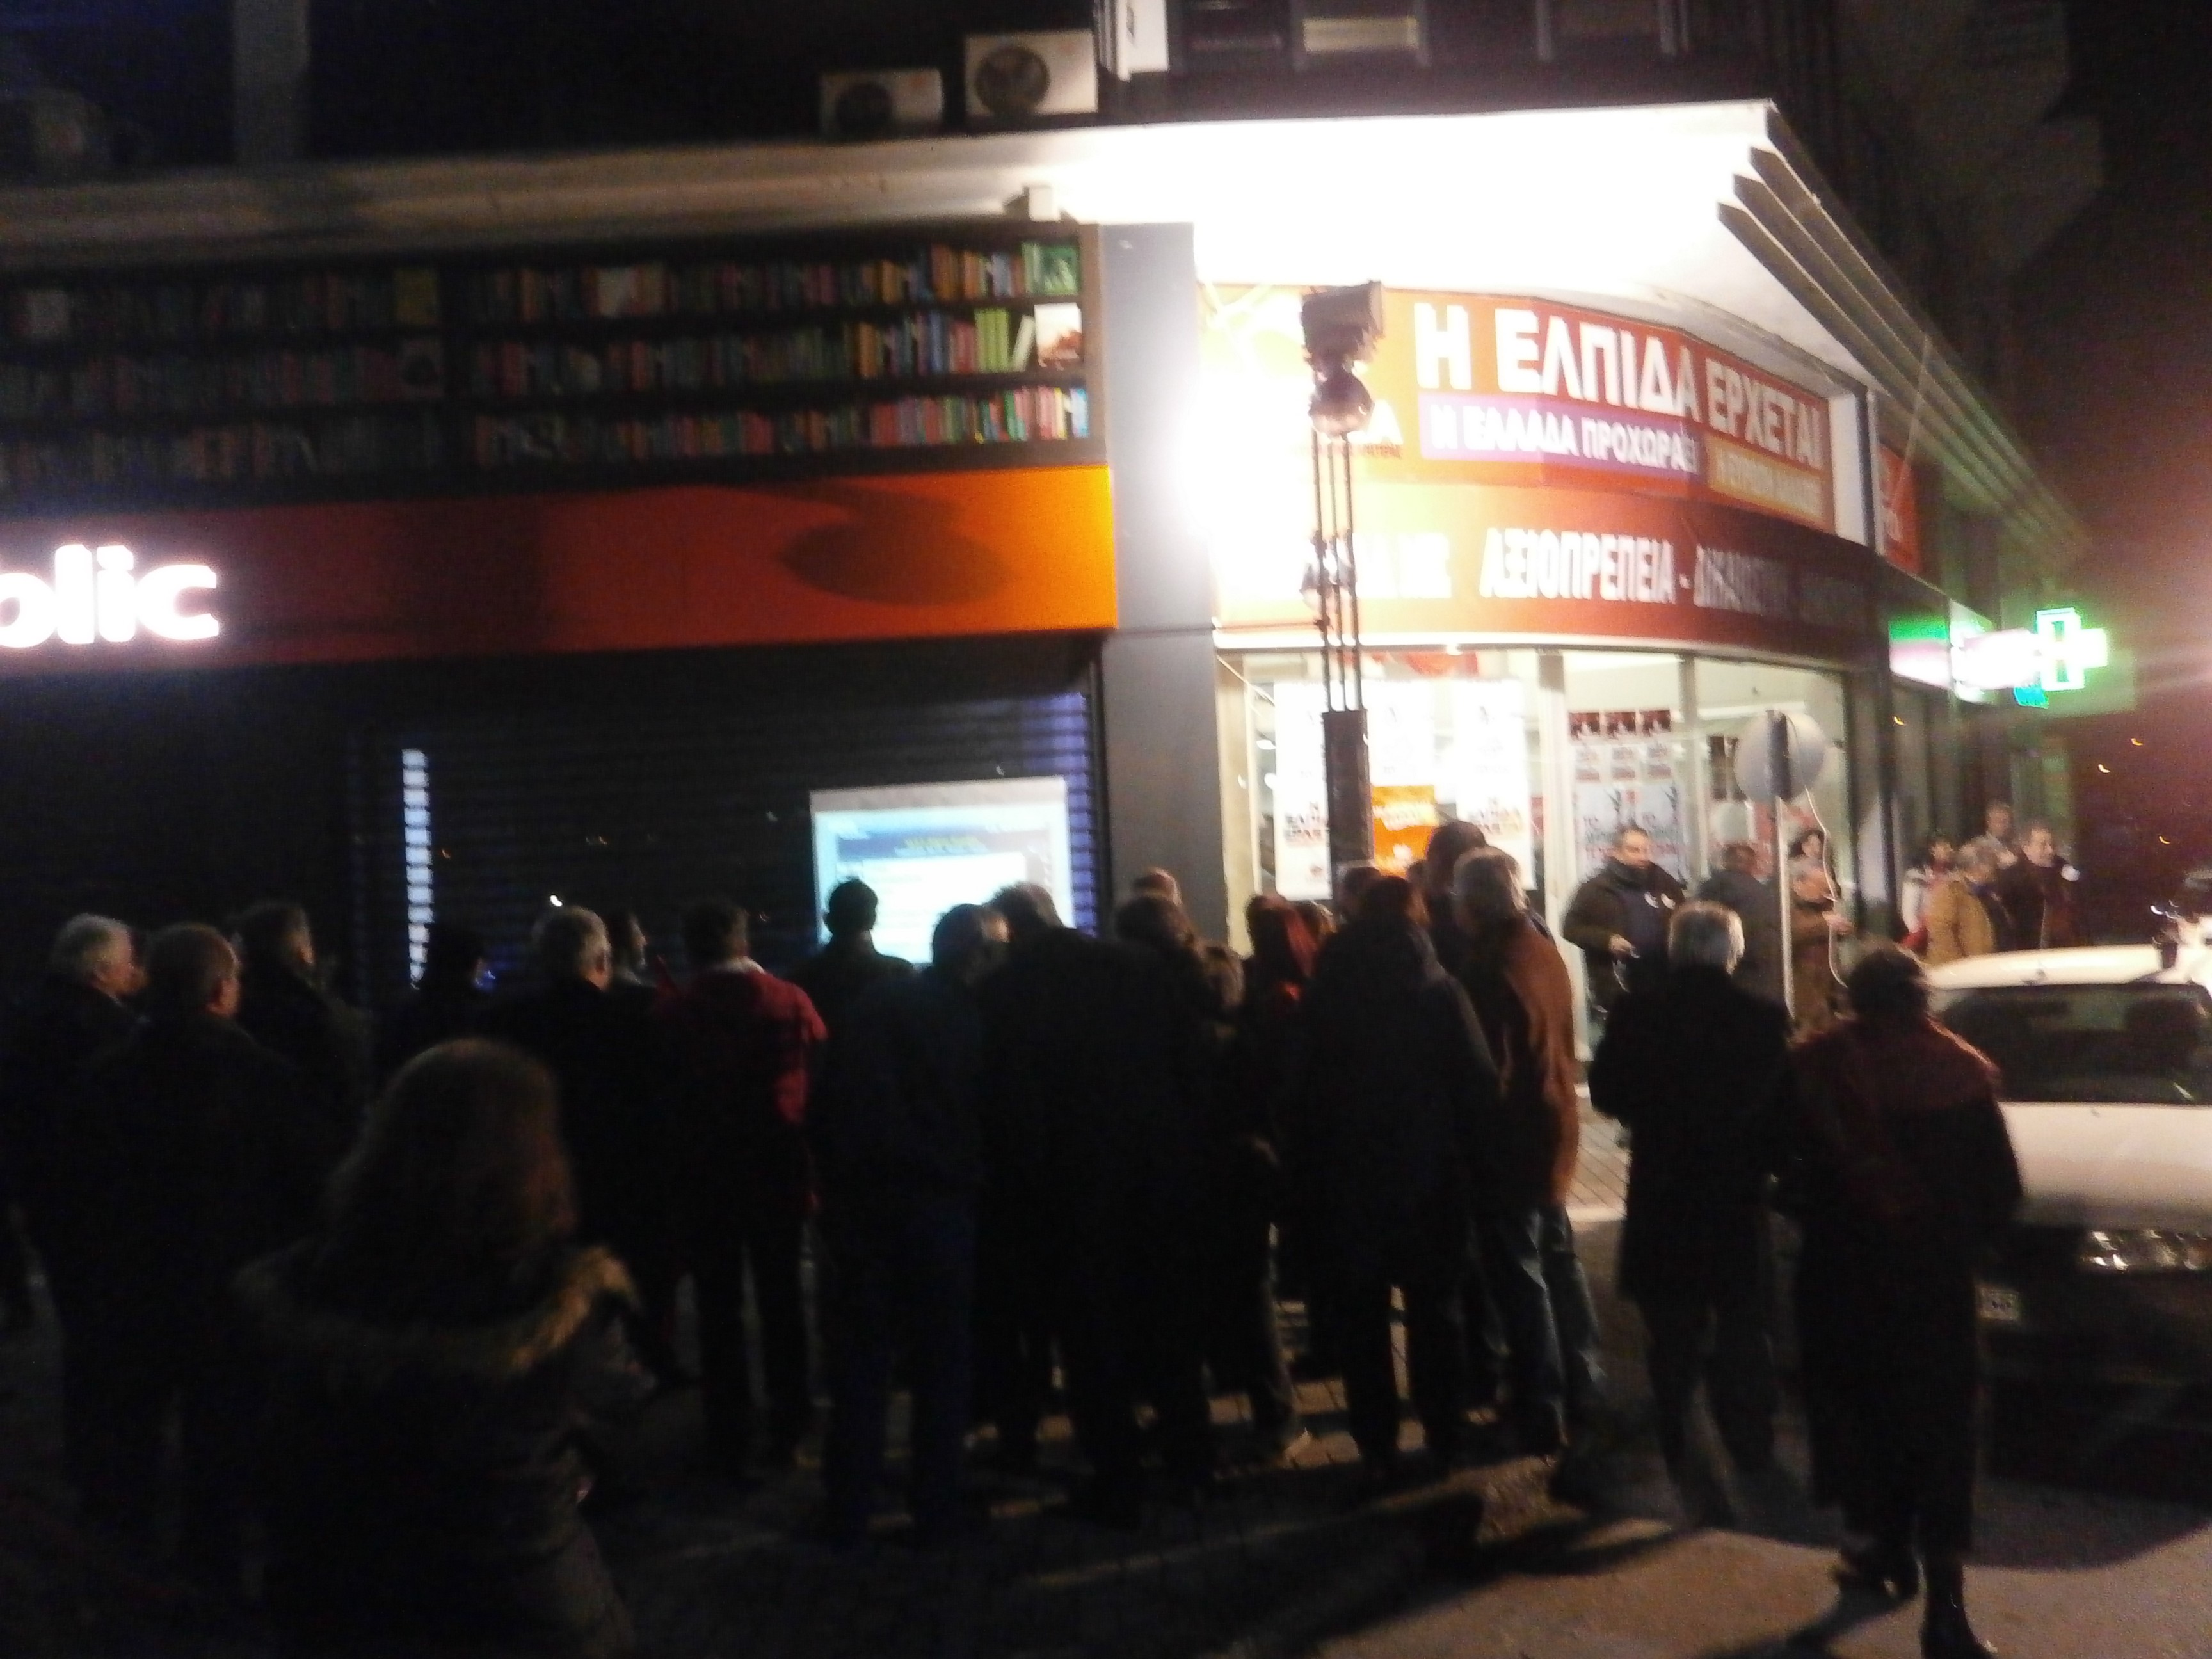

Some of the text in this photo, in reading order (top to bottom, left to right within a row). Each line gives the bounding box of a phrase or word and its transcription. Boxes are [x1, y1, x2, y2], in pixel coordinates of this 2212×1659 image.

[1413, 303, 1824, 471] Η ΕΛΠΙΔΑ ΕΡΧΕΤΑΙ
[1462, 405, 1580, 456] ΕΛΛΑΔΑ
[1479, 527, 1676, 604] ΑΞΙΟΠΡΕΠΕΙΑ
